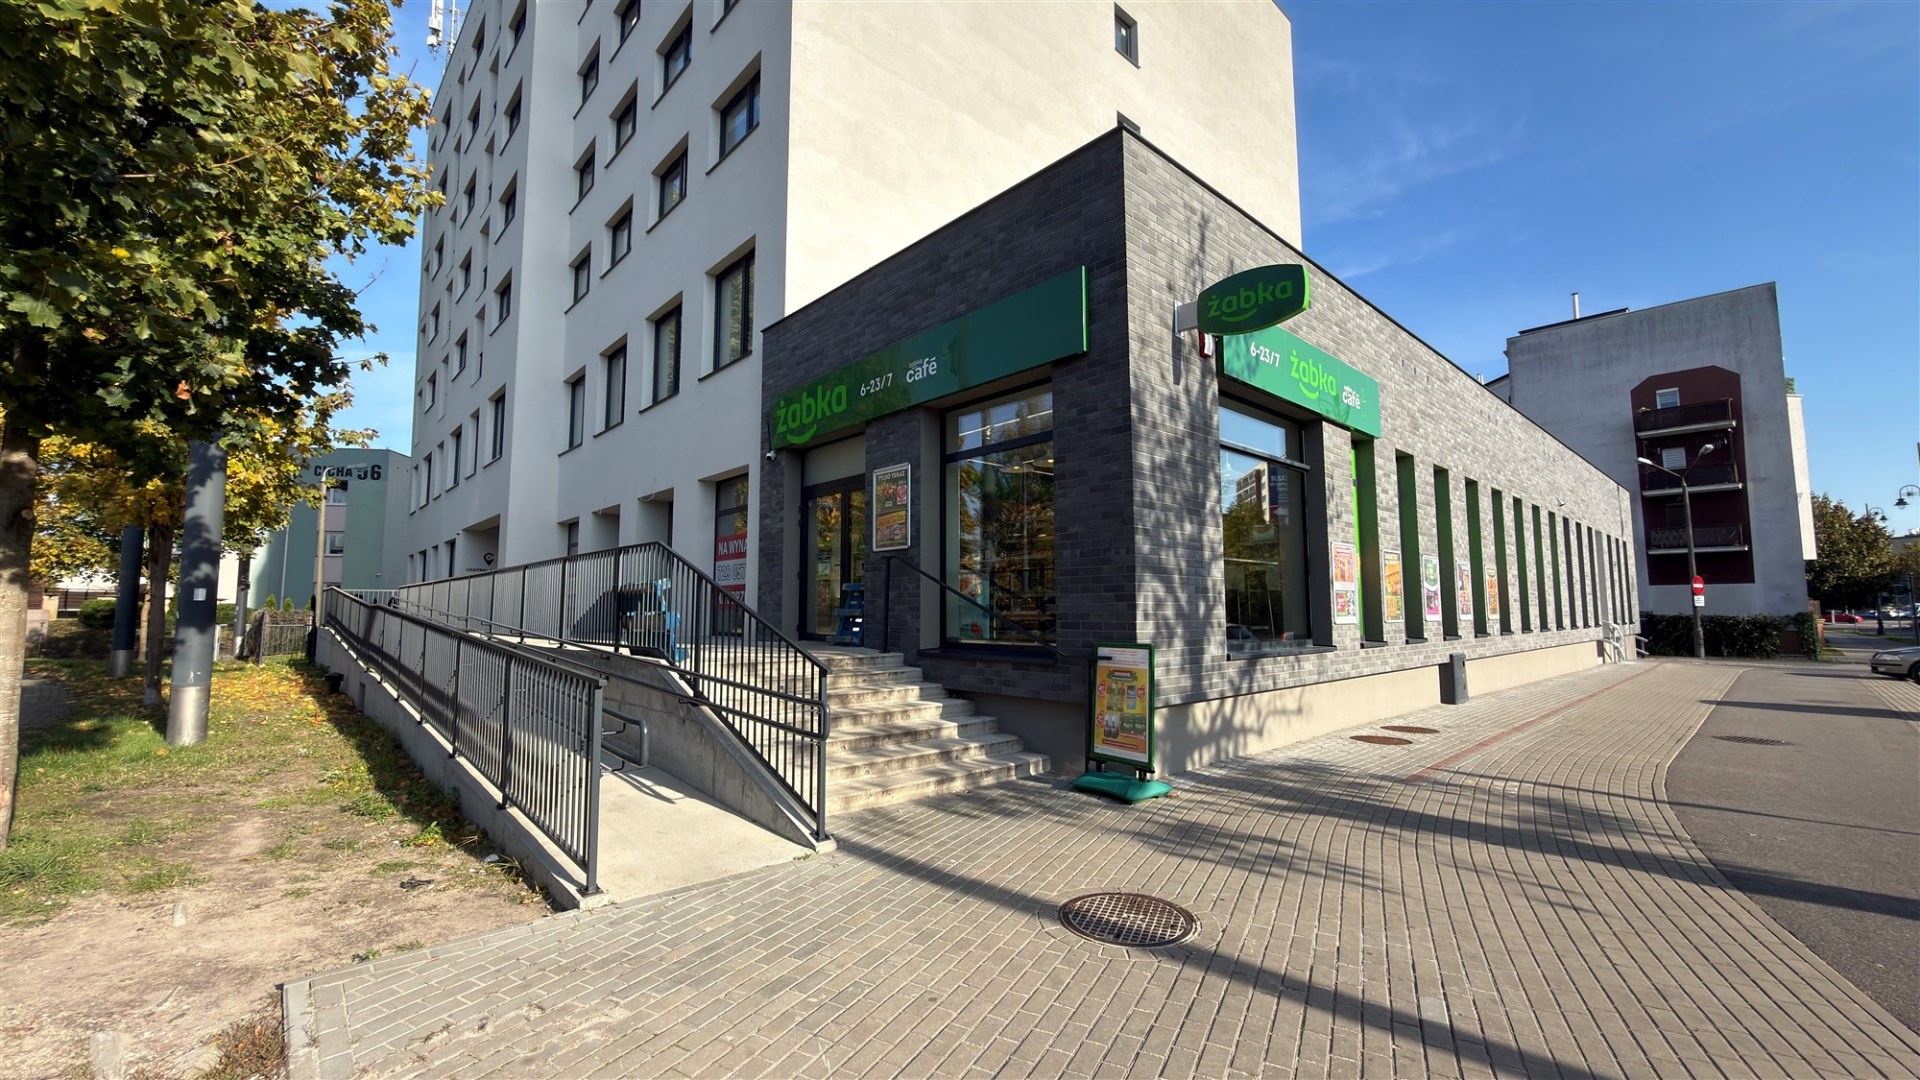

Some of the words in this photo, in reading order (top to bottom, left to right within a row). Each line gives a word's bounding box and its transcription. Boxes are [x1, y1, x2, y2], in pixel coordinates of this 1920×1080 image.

[1207, 280, 1293, 318] żabka
[1250, 342, 1280, 368] 6-23/7
[906, 357, 937, 383] café
[1290, 350, 1337, 396] żabka
[860, 373, 893, 396] 6-23/7
[776, 385, 847, 434] żabka
[1342, 391, 1361, 410] café
[718, 541, 728, 556] NA
